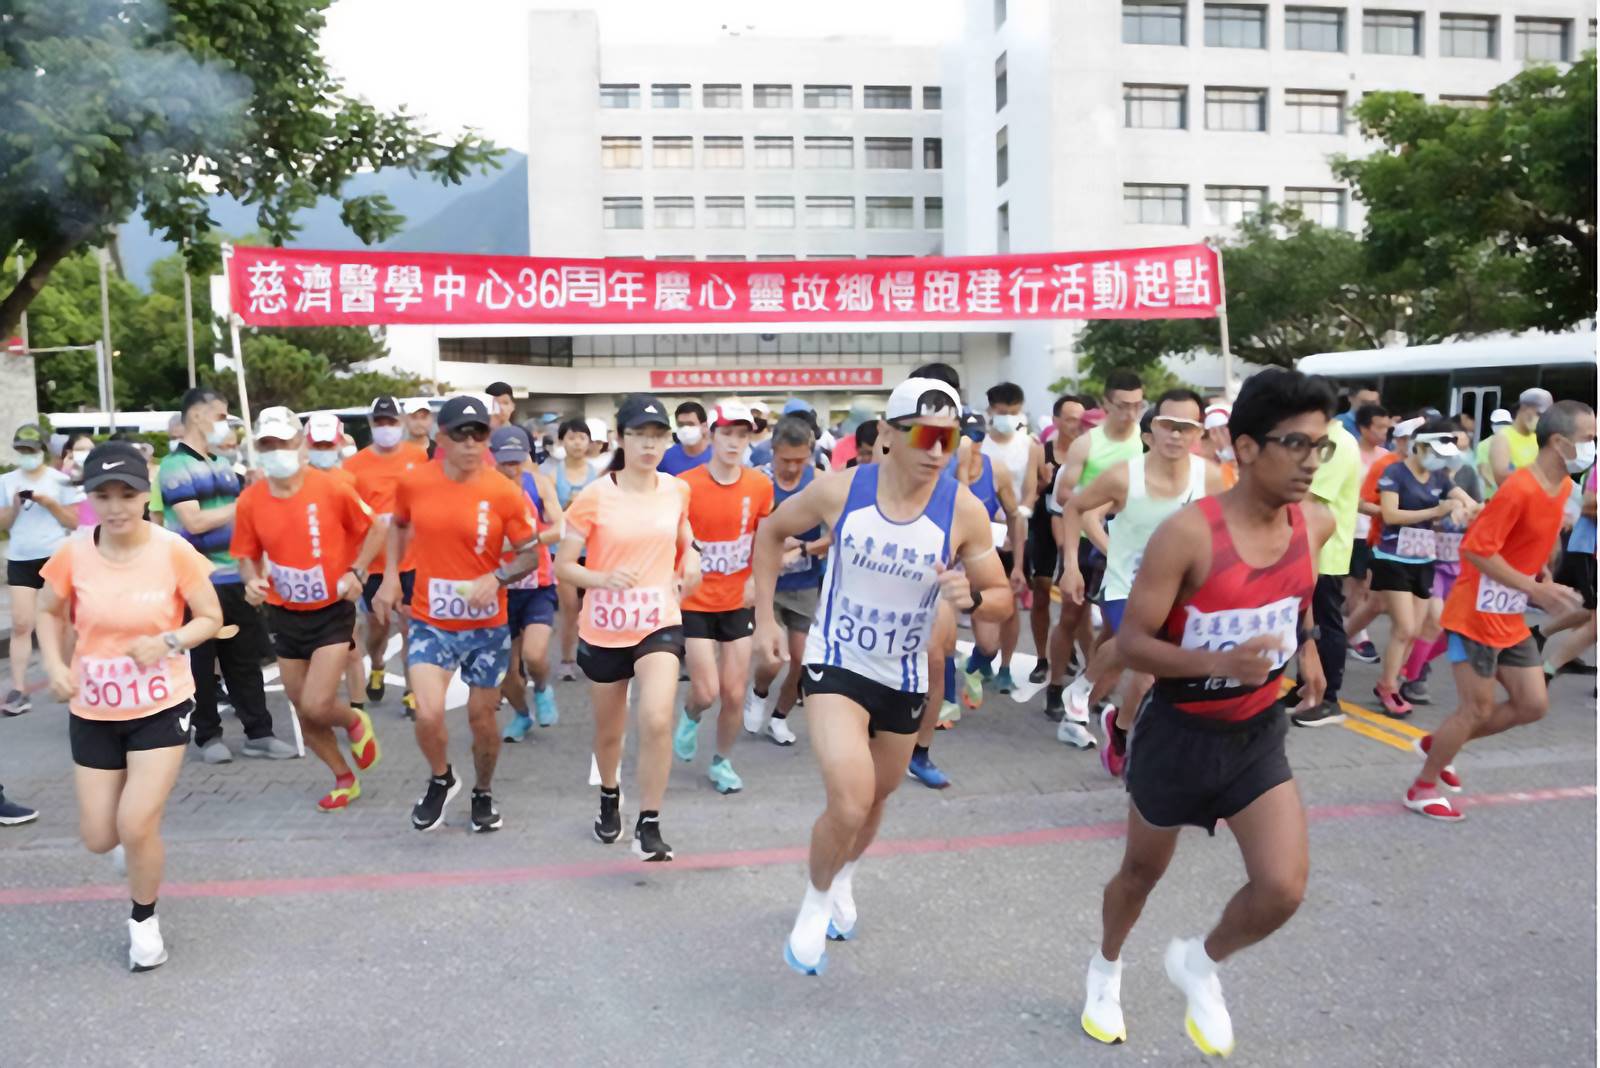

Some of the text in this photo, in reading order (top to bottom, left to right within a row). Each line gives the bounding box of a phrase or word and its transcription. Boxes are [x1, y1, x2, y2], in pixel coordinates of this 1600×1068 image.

[273, 582, 325, 601] 038
[1481, 590, 1523, 612] 202
[594, 606, 660, 630] 3014
[835, 615, 922, 654] 3015
[85, 675, 168, 707] 3016
